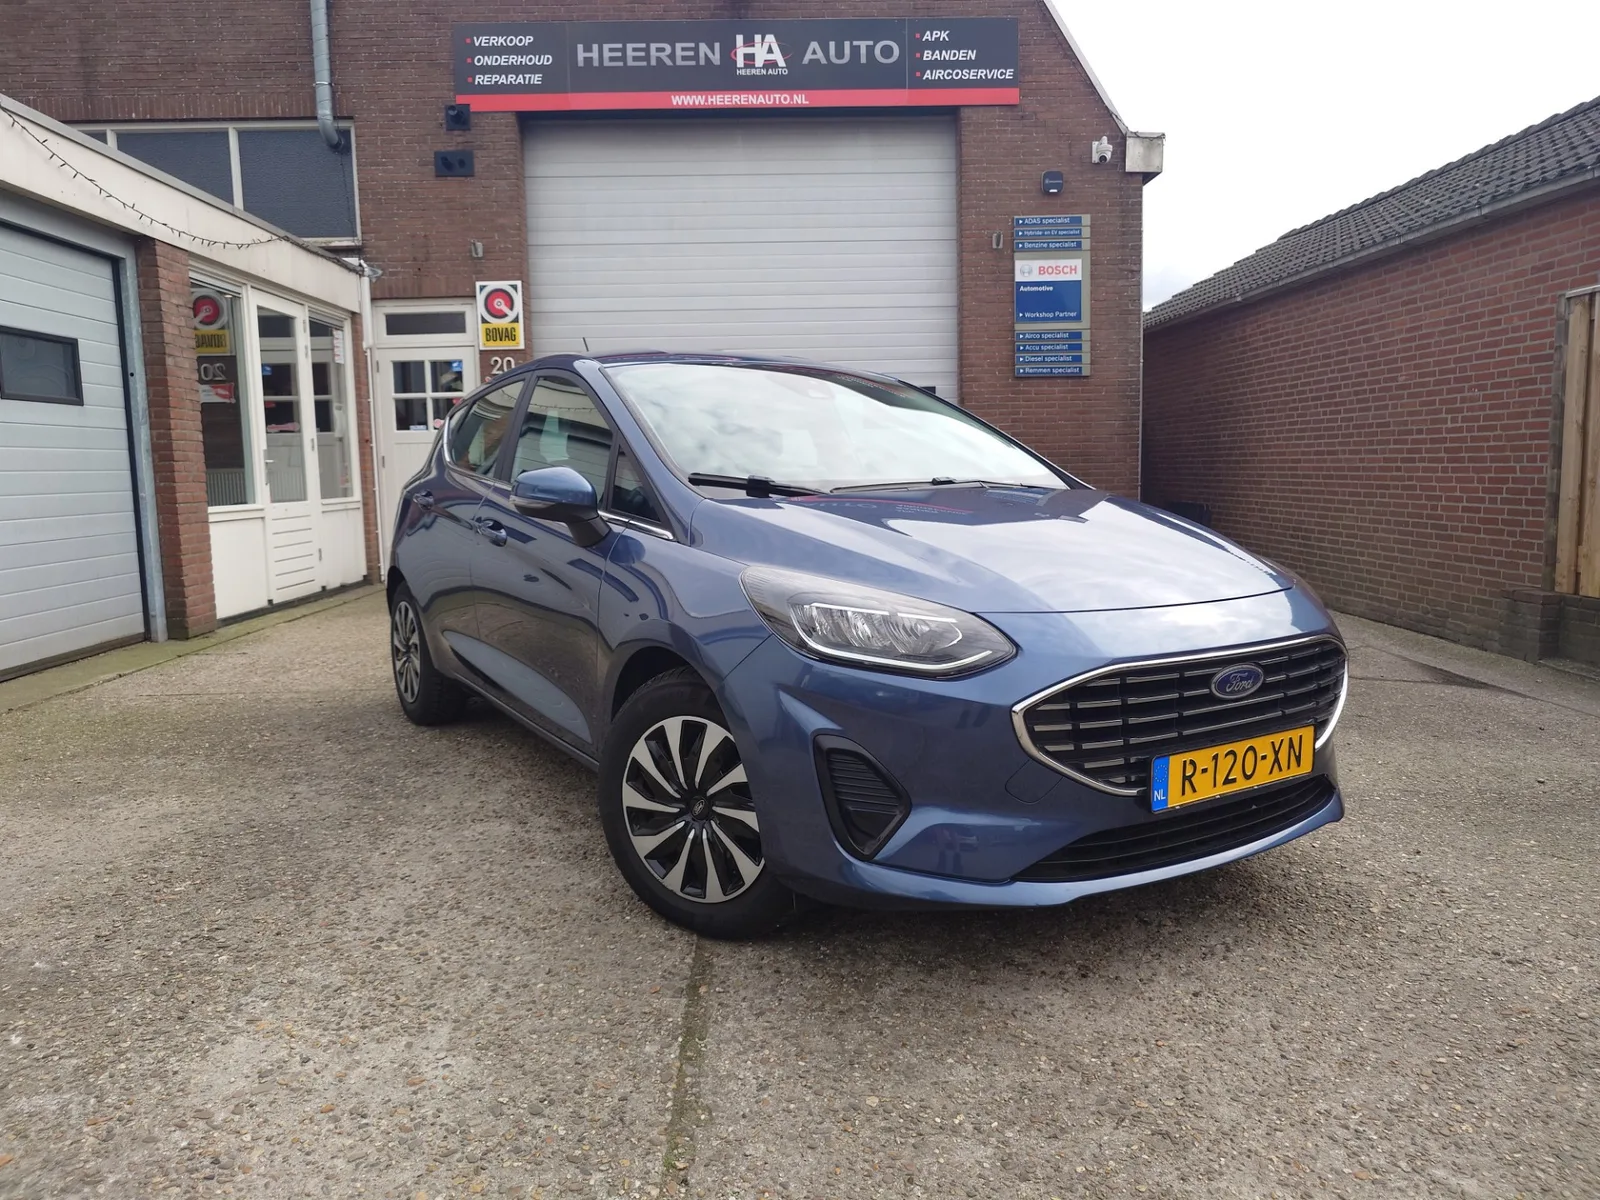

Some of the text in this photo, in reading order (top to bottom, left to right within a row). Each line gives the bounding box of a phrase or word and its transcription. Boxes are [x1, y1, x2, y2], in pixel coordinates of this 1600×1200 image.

[473, 36, 534, 47] VERKOOP
[922, 30, 950, 42] APK
[577, 33, 900, 68] HEEREN HA AUTO
[922, 49, 976, 61] BANDEN
[474, 54, 553, 66] ONDERHOUD
[474, 73, 543, 85] REPARATIE
[922, 68, 1014, 80] AIRCOSERVICE
[671, 94, 809, 106] WWW.HEERENAUTO.NL
[1038, 265, 1077, 275] BOSCH
[485, 327, 516, 342] BOVAG
[490, 356, 515, 375] 20
[1226, 672, 1254, 692] Ford
[1181, 734, 1303, 796] R-120-XN
[1154, 789, 1166, 801] NL
